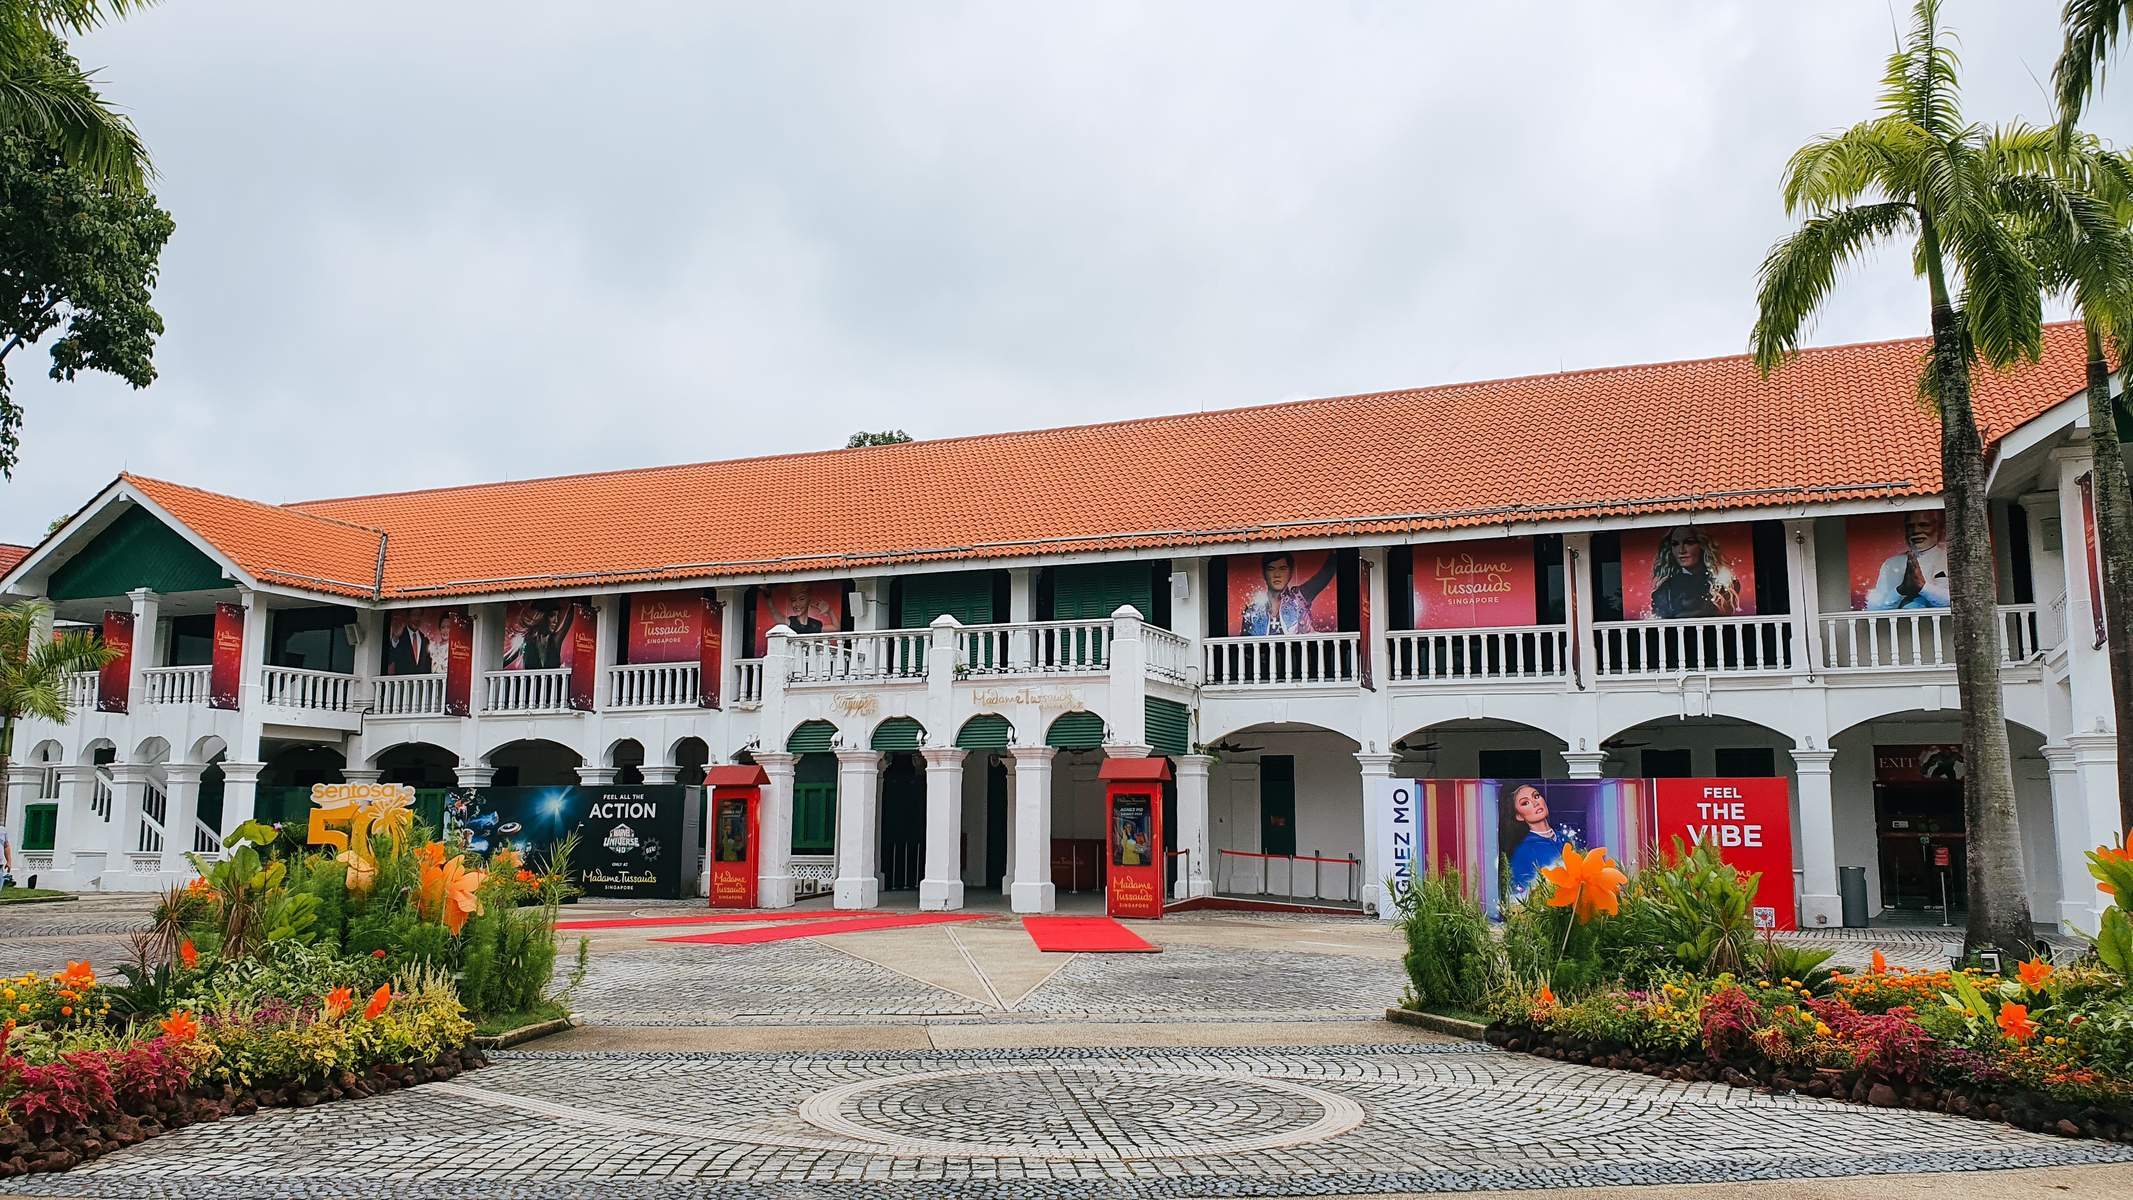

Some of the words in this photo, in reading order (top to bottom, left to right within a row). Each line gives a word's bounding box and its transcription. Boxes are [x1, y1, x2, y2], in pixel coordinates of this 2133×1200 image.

[1435, 552, 1513, 577] Madame
[1434, 573, 1512, 596] Tussauds
[1447, 596, 1500, 605] SINGAPORE
[640, 602, 692, 621] Madame
[640, 618, 690, 637] Tussauds
[646, 637, 681, 645] SINGAPORE
[972, 688, 1023, 707] Madame
[1880, 757, 1915, 769] EXIT
[311, 782, 395, 799] sentosa
[1703, 787, 1743, 799] FEEL
[589, 802, 657, 819] ACTION
[1393, 788, 1409, 824] MO
[1696, 802, 1746, 820] THE
[603, 836, 640, 848] UNIVERSE
[1686, 824, 1763, 848] VIBE
[582, 868, 622, 883] Madame
[618, 870, 657, 883] Tussauds
[714, 871, 747, 883] Madame
[1113, 875, 1153, 890] Madame
[714, 883, 746, 894] Tussauds
[1113, 888, 1153, 902] Tussauds
